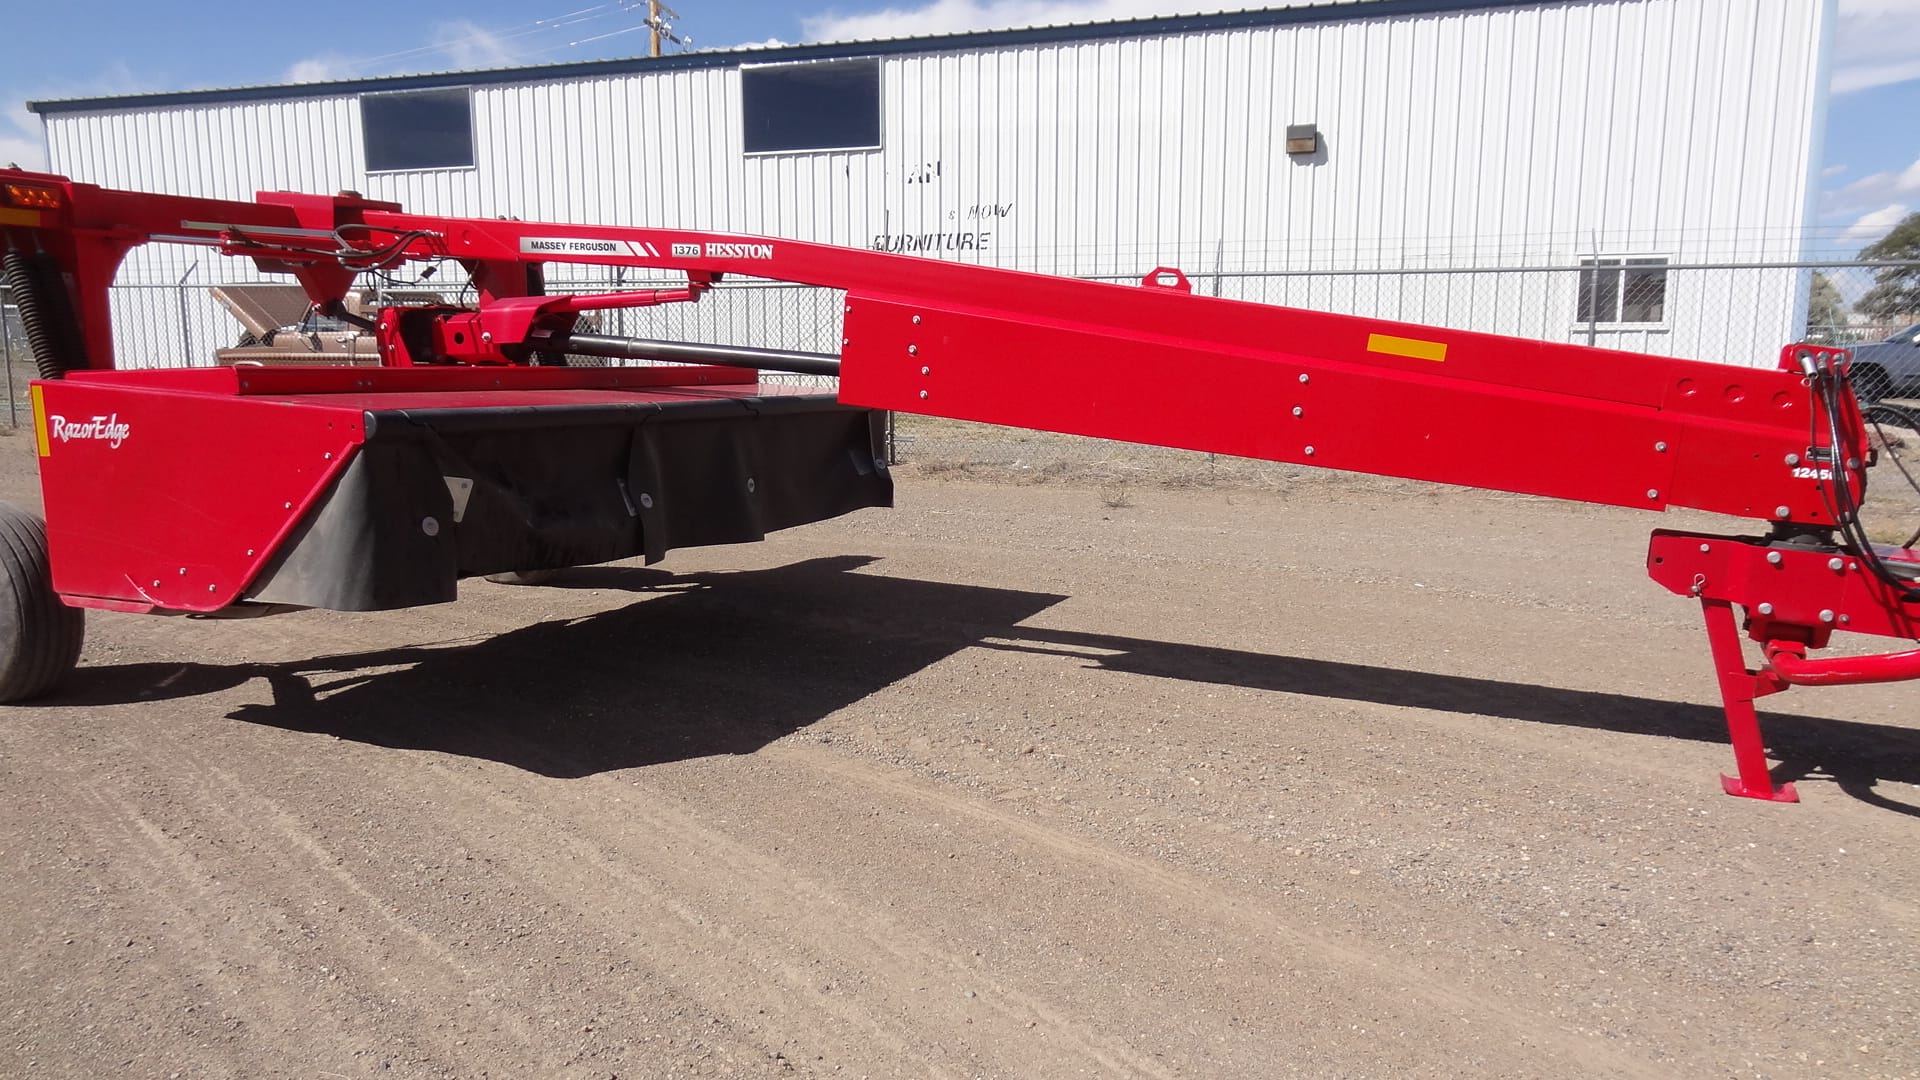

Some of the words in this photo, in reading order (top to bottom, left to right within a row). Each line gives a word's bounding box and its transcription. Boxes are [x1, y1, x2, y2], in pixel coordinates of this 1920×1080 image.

[531, 240, 566, 250] MASSEY
[569, 242, 617, 252] FERGUSON
[674, 245, 699, 256] 1376
[704, 242, 774, 260] HESSTON
[872, 232, 991, 252] FURNITURE
[50, 412, 130, 450] RazorEdge
